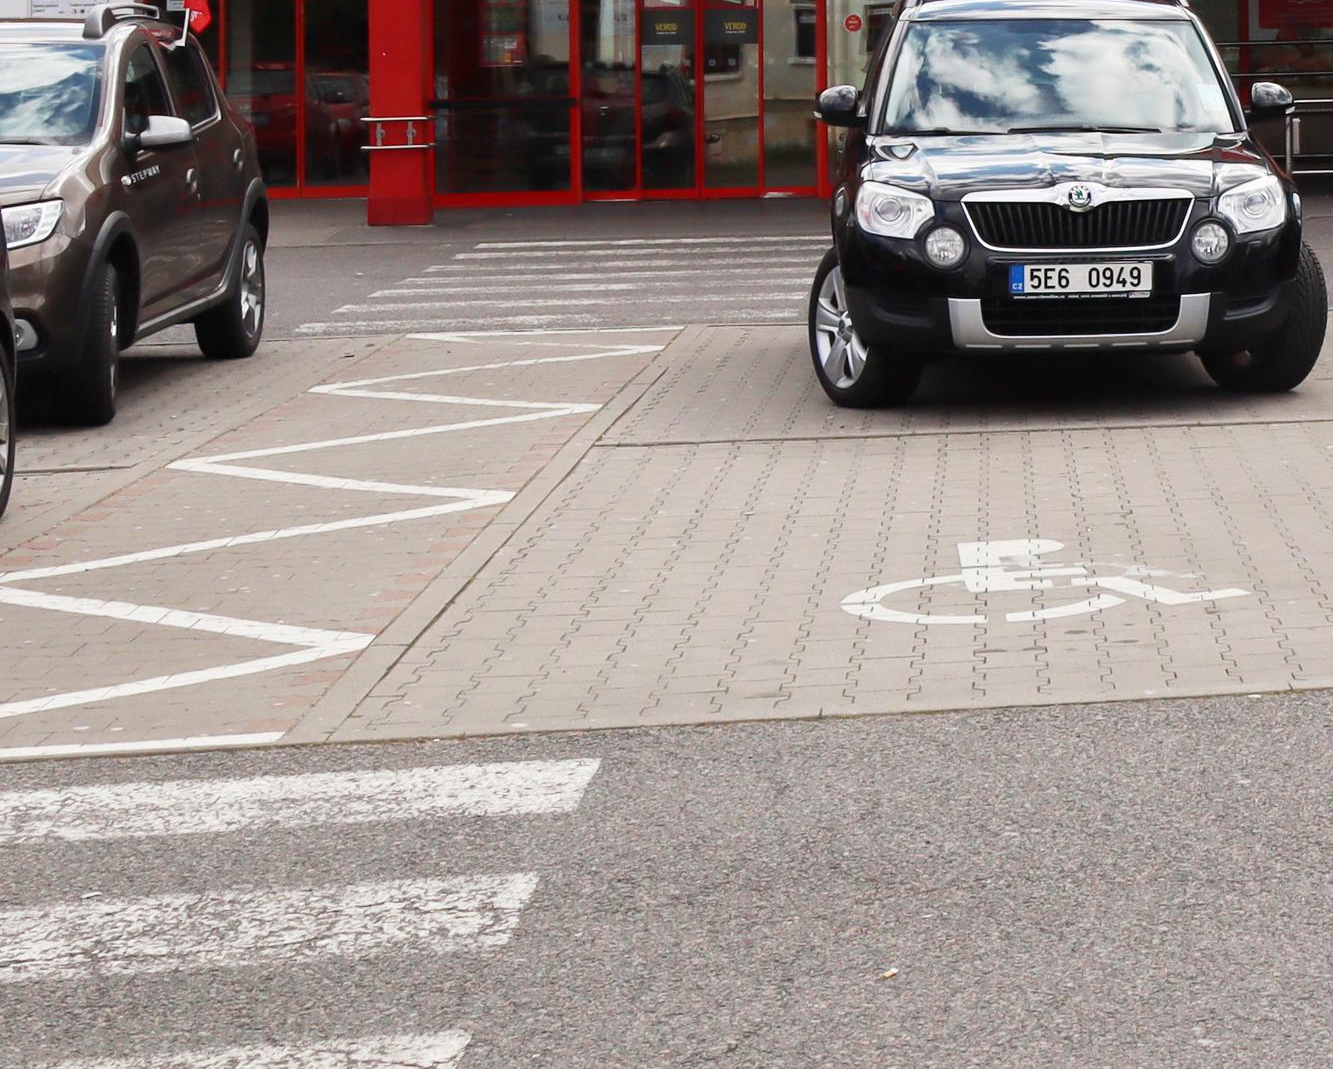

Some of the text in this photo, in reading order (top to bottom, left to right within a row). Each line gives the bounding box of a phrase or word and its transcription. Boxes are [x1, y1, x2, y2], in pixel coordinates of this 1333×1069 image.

[131, 165, 160, 183] STEPWAY
[1029, 266, 1142, 289] 5E6 0949
